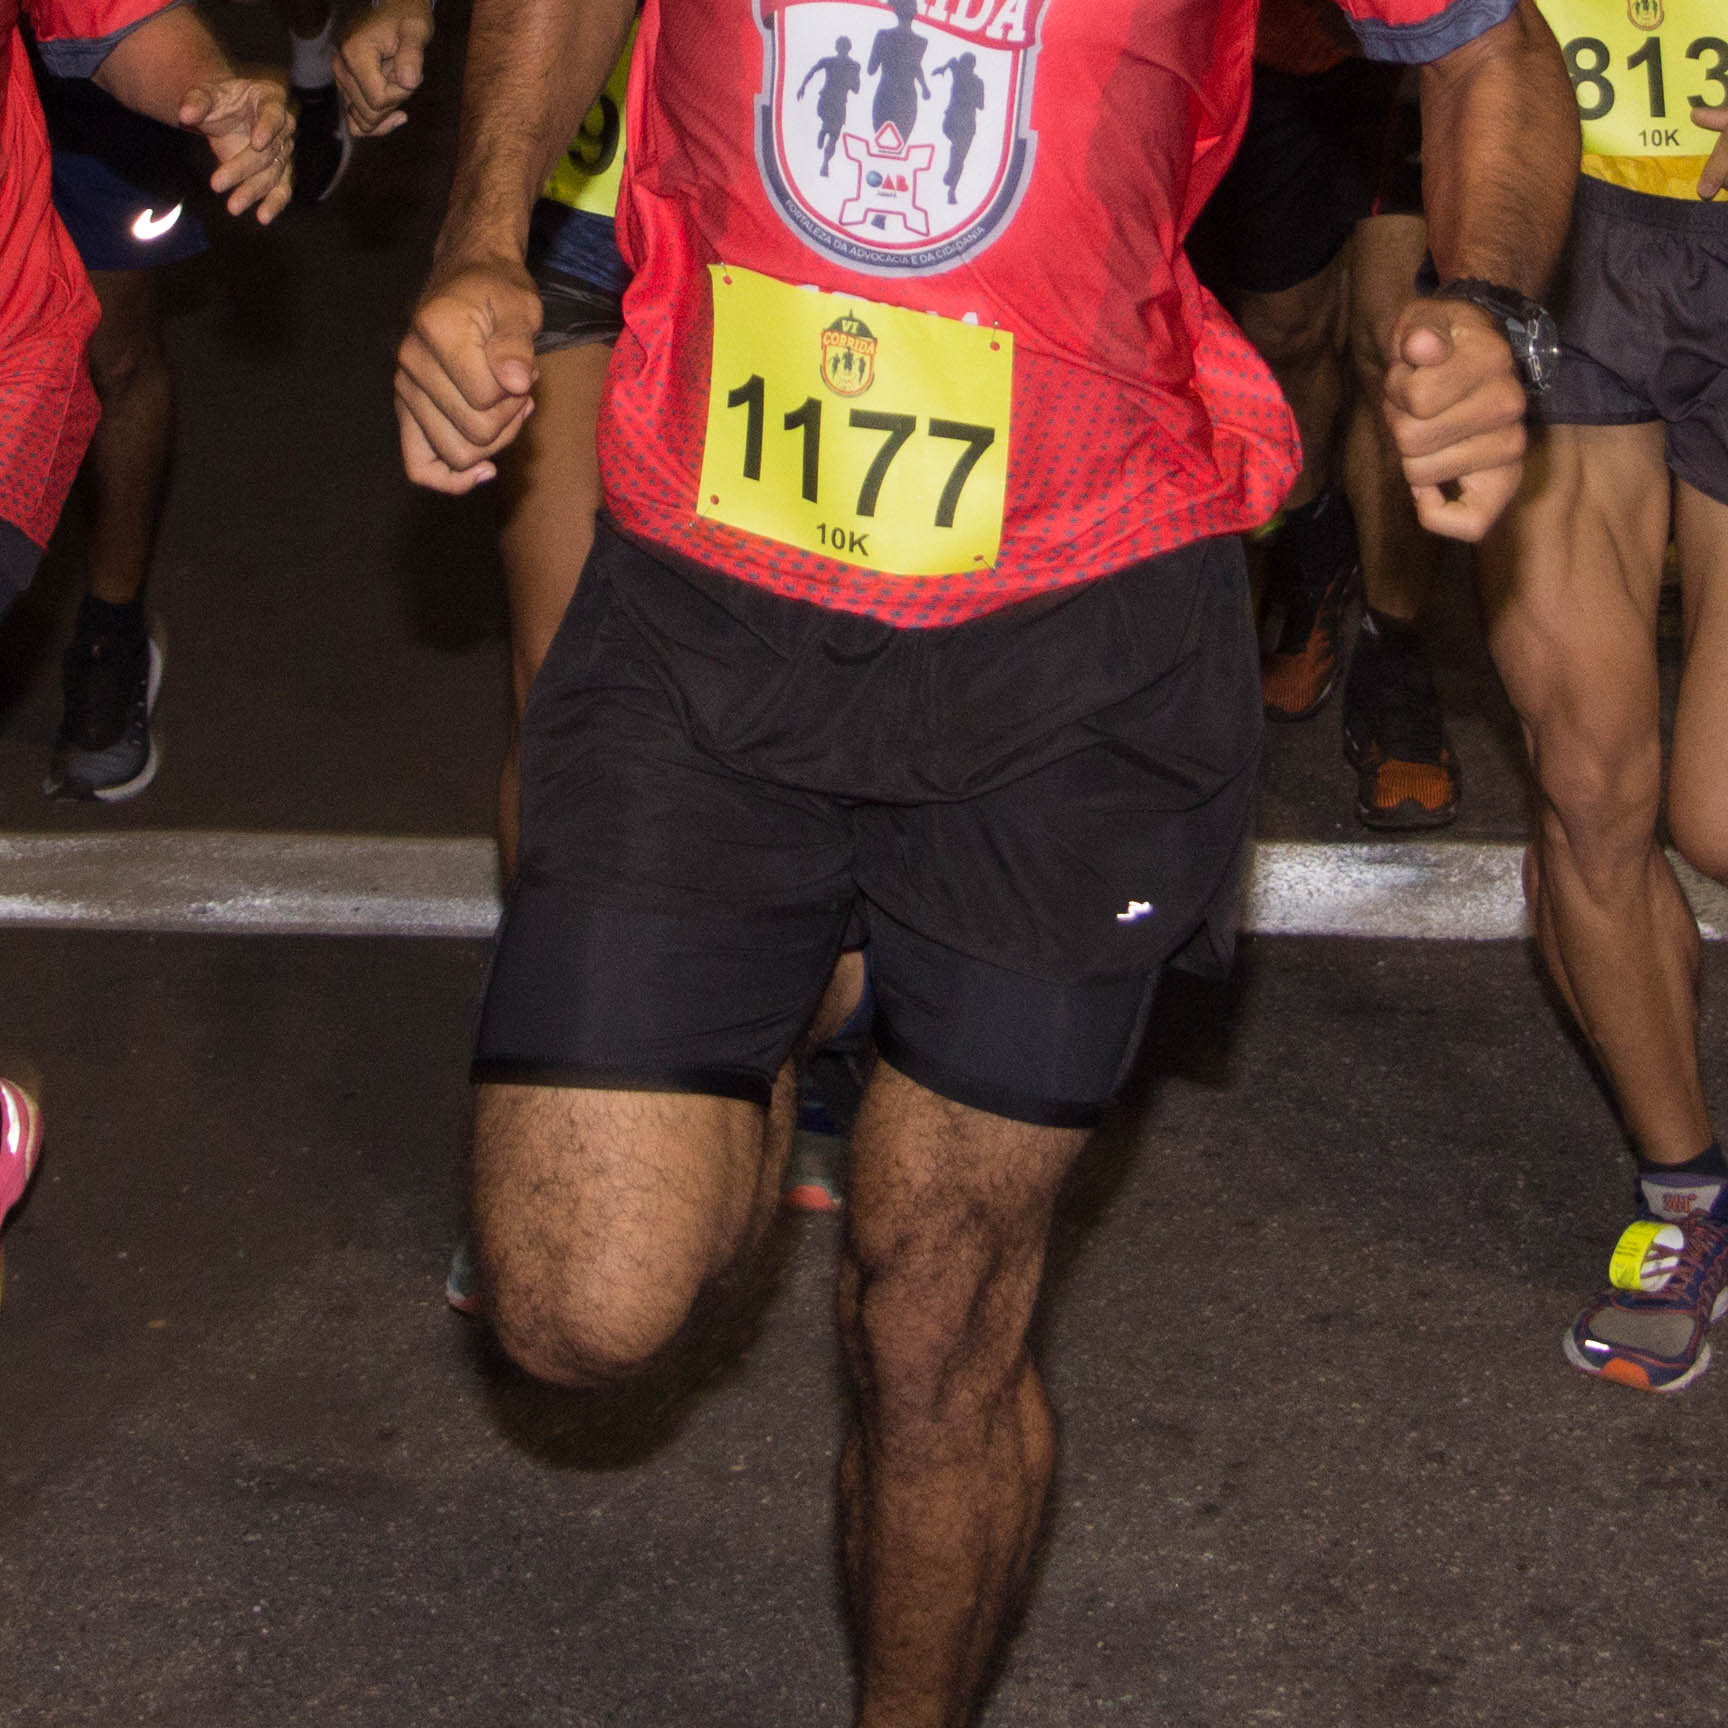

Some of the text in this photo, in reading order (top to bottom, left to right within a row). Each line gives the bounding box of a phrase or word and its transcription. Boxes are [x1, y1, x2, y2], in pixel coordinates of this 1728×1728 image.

[1638, 128, 1680, 148] 10K
[783, 198, 832, 247] FORTALEZA
[849, 245, 911, 265] ADVOCACIA
[935, 226, 987, 260] CIDADANIA
[840, 319, 859, 334] VI
[822, 331, 878, 356] CORRIDA
[727, 373, 996, 529] 1177
[816, 523, 870, 557] 10K
